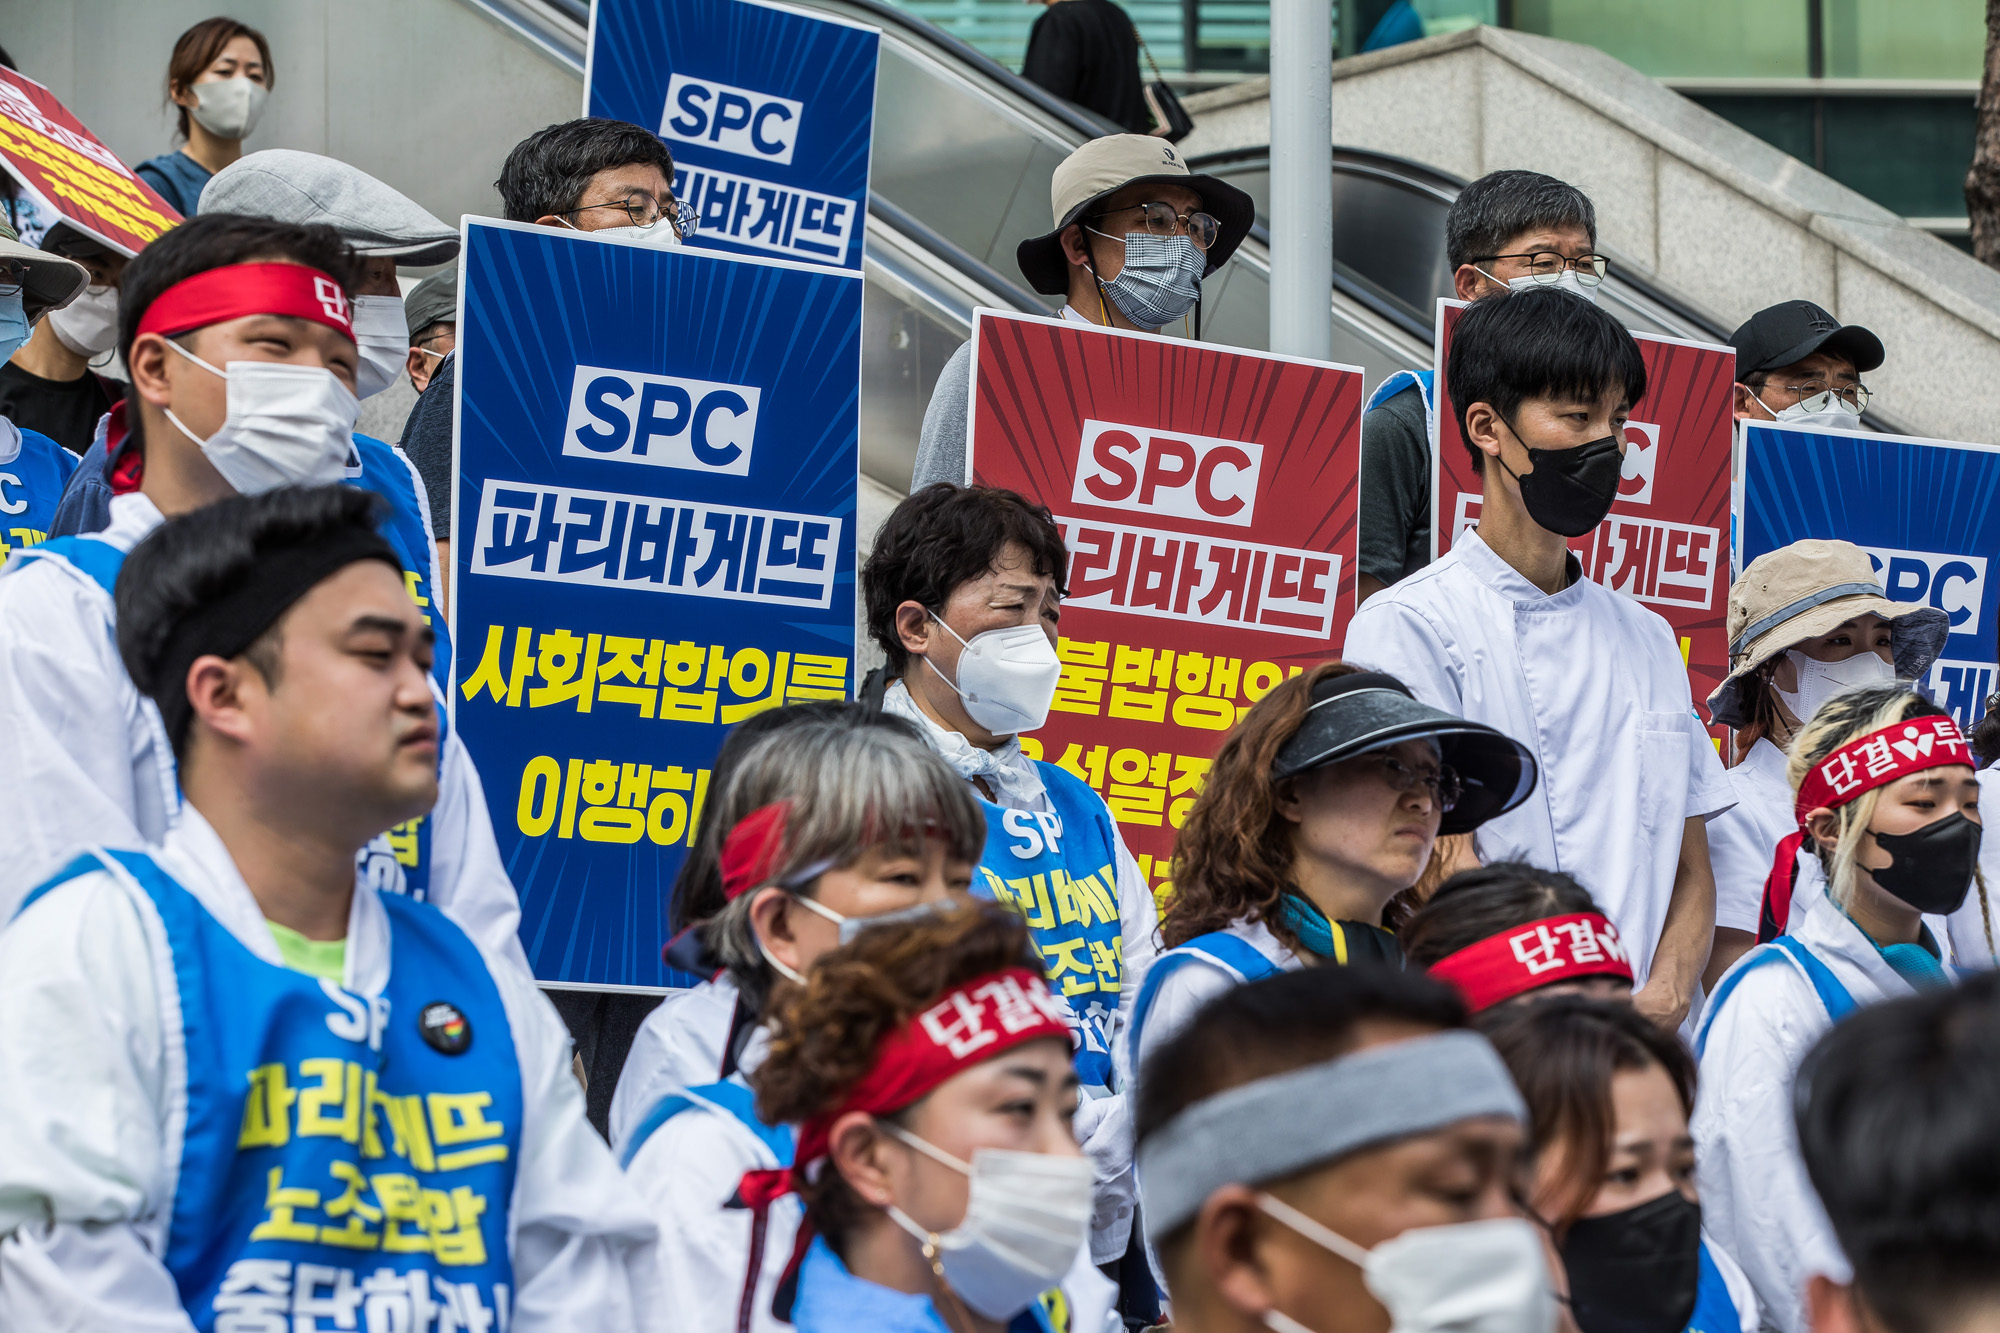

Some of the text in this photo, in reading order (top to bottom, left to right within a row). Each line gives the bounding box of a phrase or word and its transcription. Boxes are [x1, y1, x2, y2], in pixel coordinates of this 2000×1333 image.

[669, 83, 793, 155] SPC
[671, 170, 847, 258] 리바게뜨
[575, 375, 750, 467] SPC
[1083, 429, 1252, 518] SPC
[483, 487, 831, 601] 파리바게뜨
[1060, 523, 1332, 633] 리바게뜨
[1867, 552, 1978, 627] PC
[460, 624, 848, 725] 사회적합의를
[516, 754, 712, 848] 이행하
[1821, 721, 1977, 796] 단결 투
[1002, 809, 1064, 860] SP
[1508, 918, 1605, 976] 단결
[918, 974, 1044, 1060] 단결
